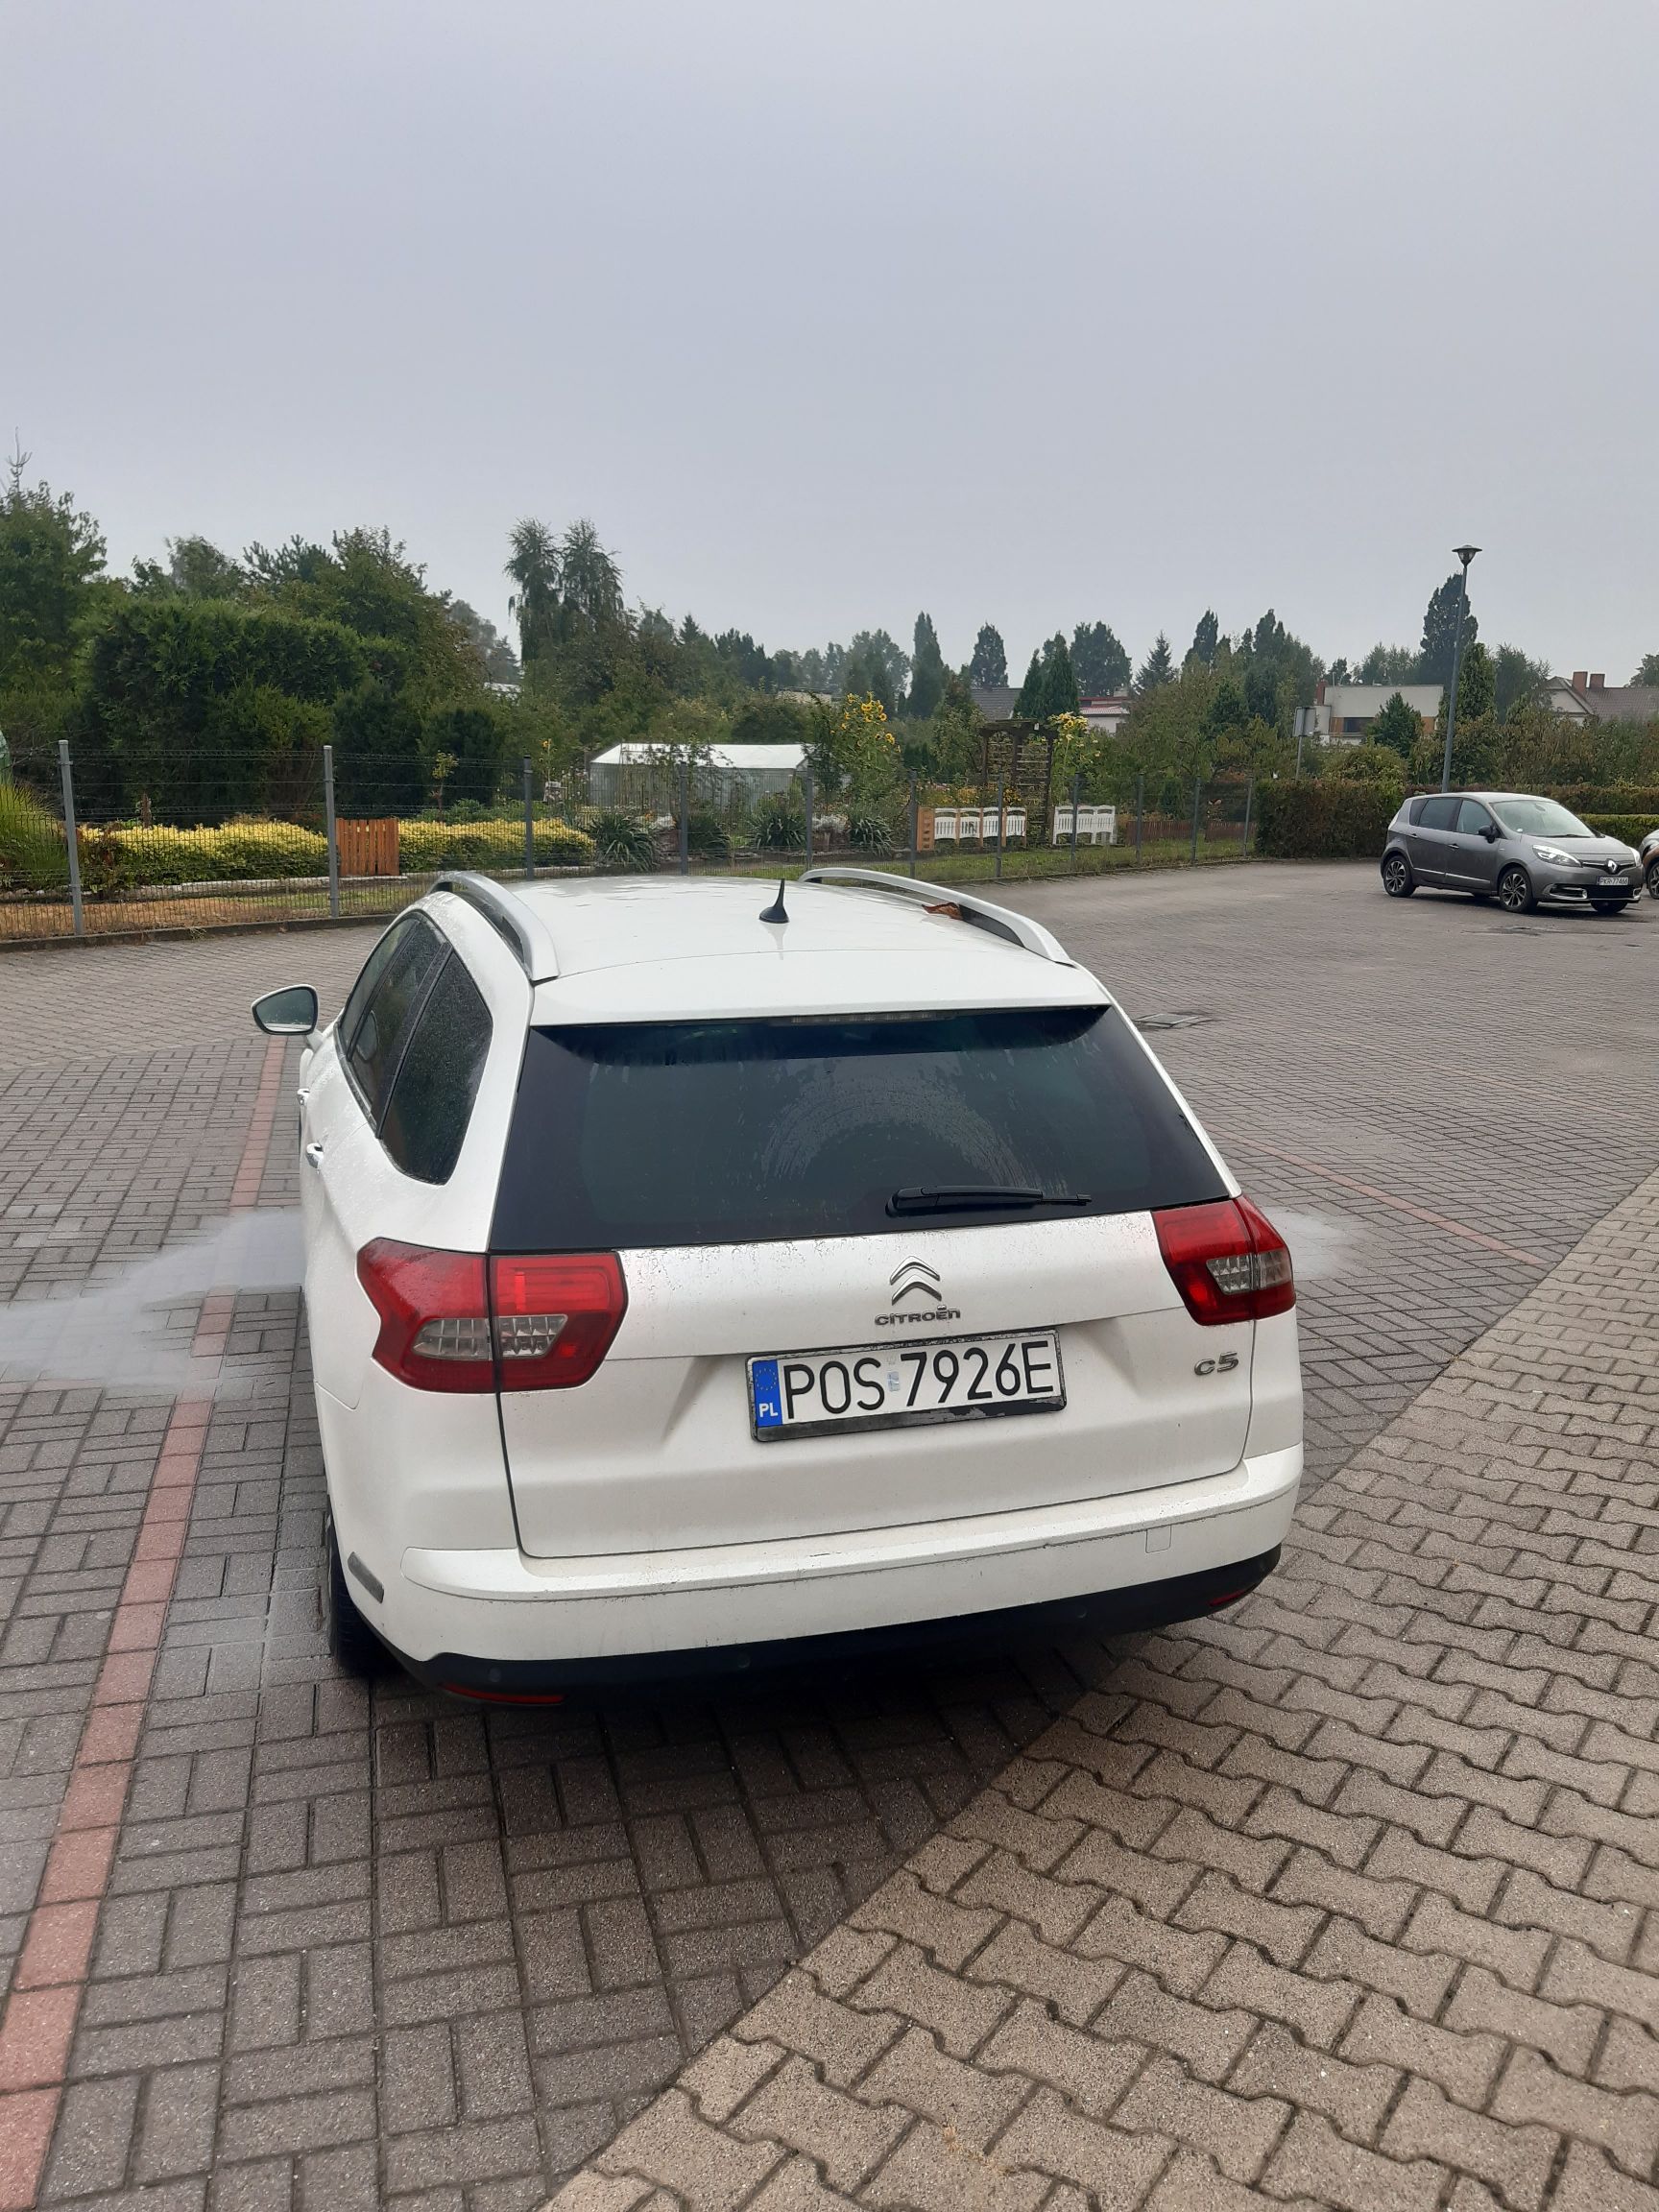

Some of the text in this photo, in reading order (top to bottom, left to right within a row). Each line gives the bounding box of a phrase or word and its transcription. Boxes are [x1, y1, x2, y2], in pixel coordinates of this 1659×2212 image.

[1194, 1352, 1238, 1375] C5
[783, 1340, 1053, 1419] POS 7926E
[758, 1403, 779, 1418] PL
